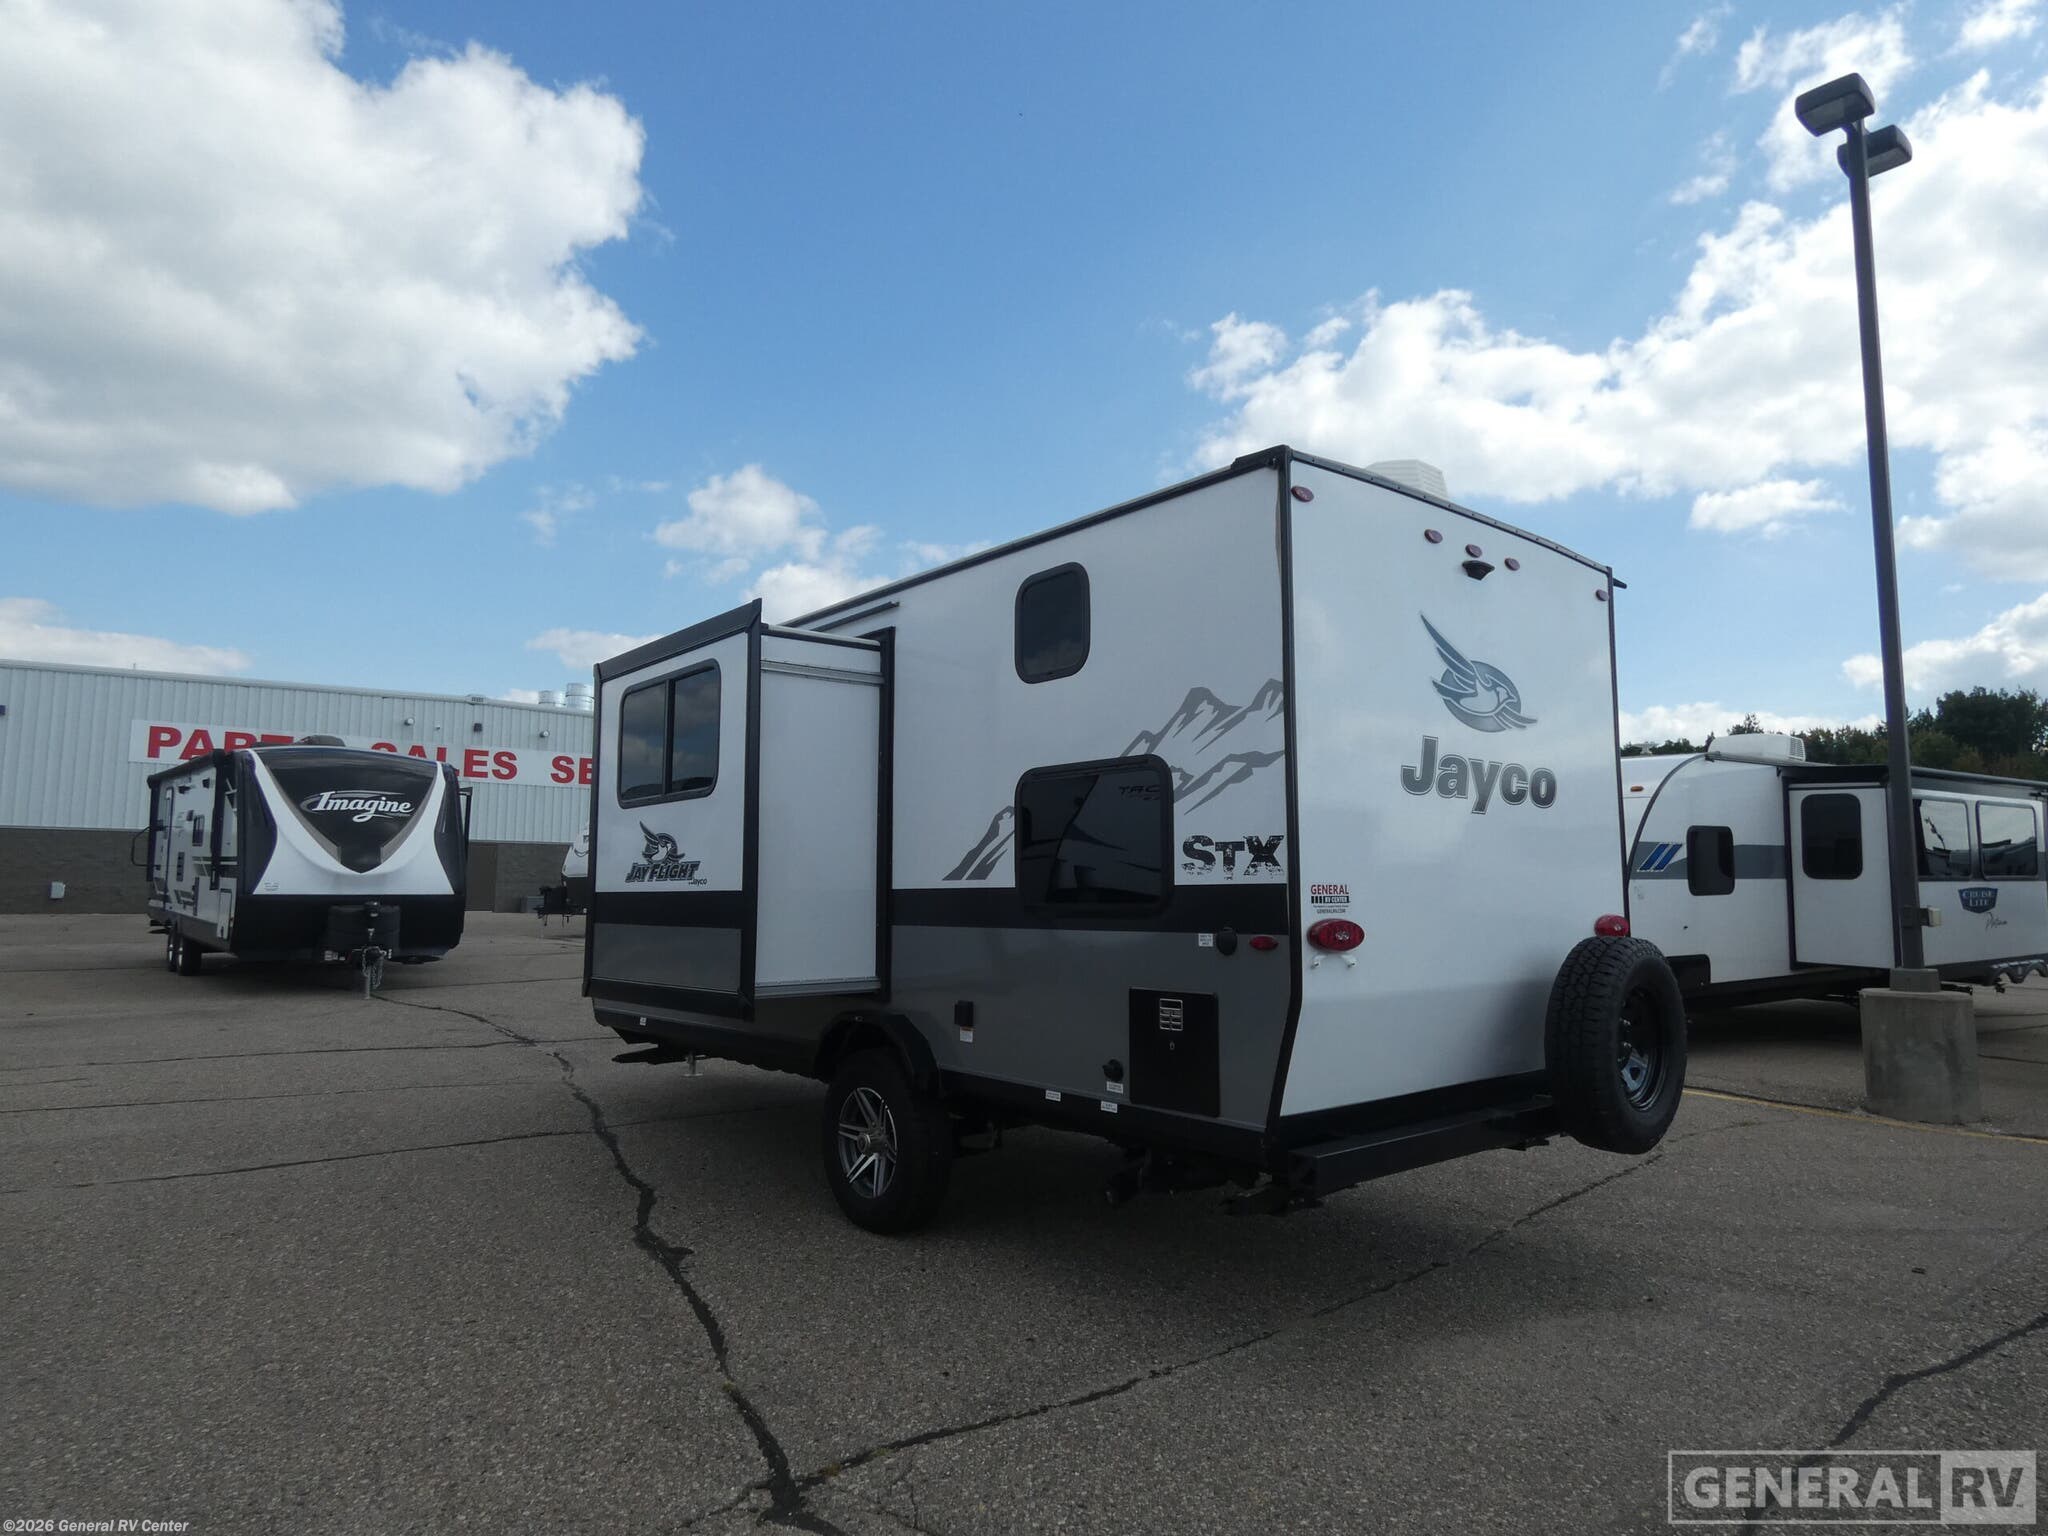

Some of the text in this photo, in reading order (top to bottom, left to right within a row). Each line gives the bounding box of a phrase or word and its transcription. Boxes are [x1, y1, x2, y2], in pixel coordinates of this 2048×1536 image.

[371, 742, 518, 780] LES
[1400, 735, 1558, 814] Jayco
[312, 791, 414, 822] Imagine
[625, 861, 701, 883] JAY FLIGHT
[1181, 834, 1285, 880] STX
[1311, 884, 1349, 895] GENERAL
